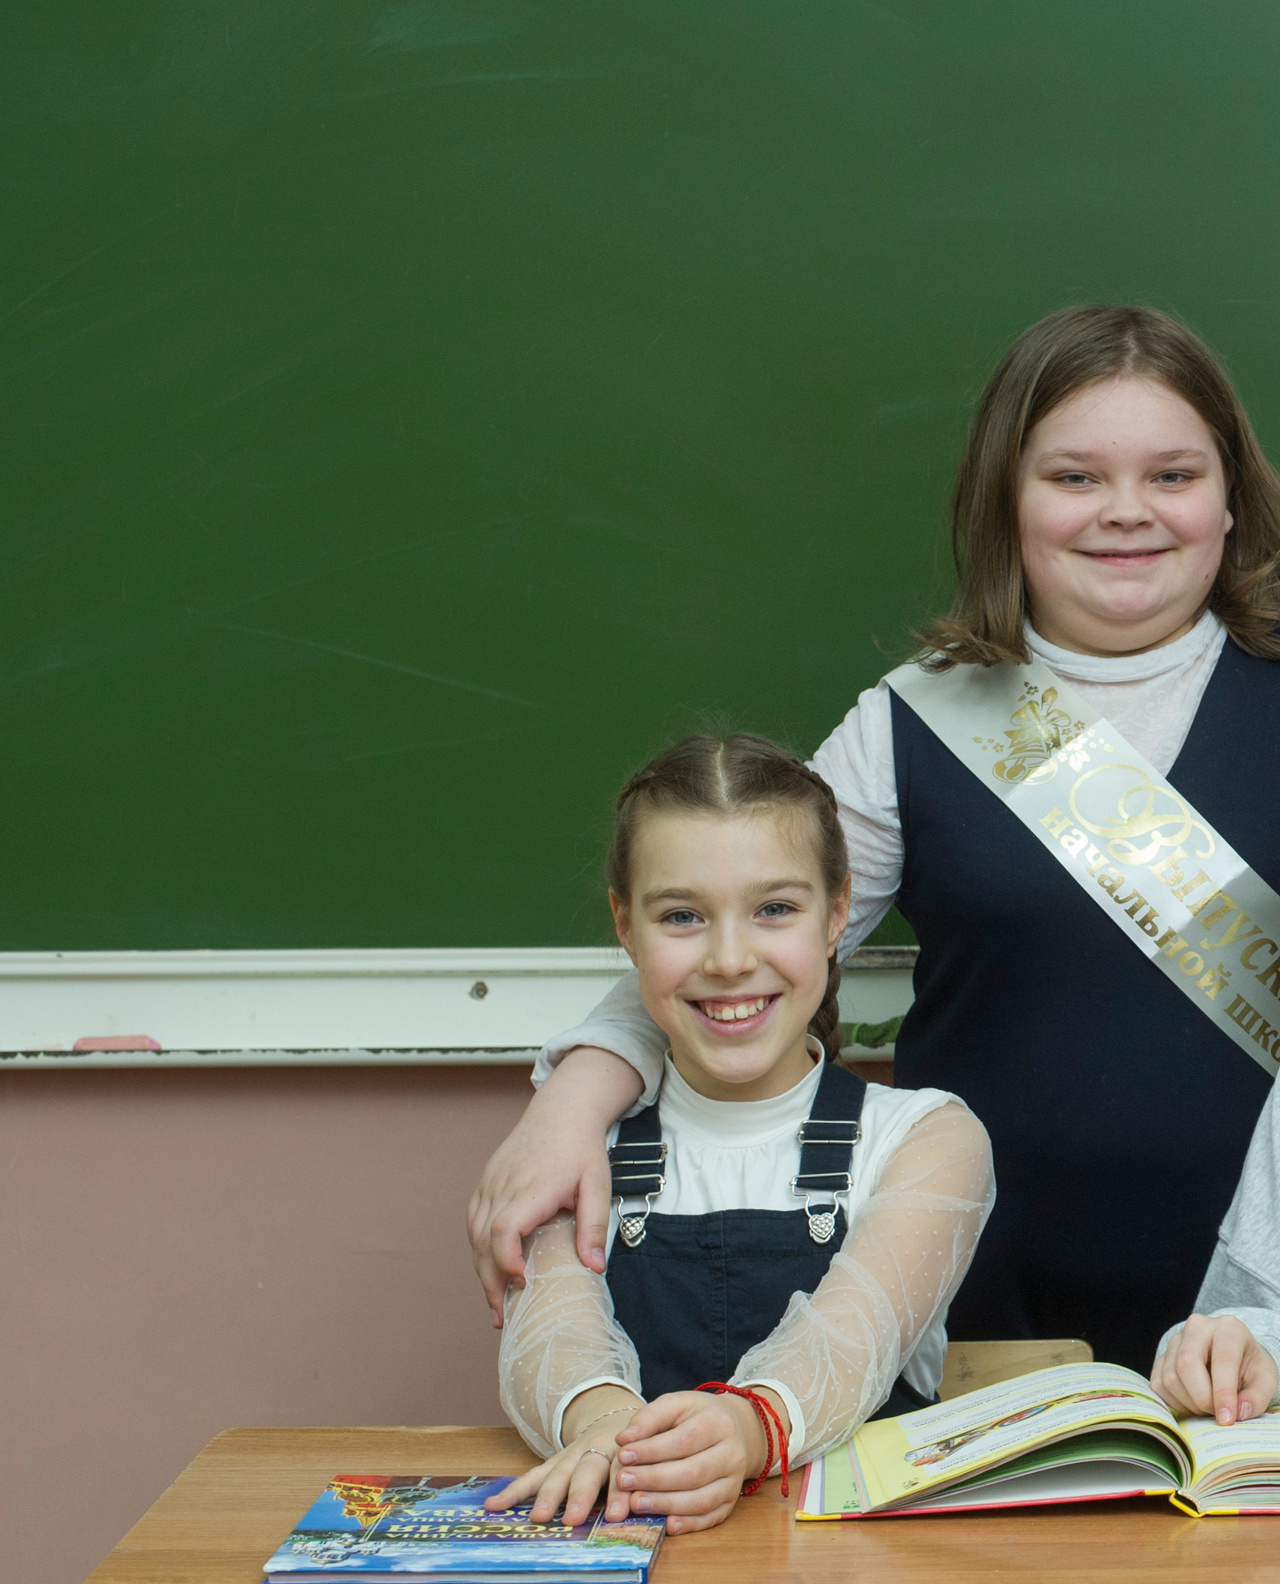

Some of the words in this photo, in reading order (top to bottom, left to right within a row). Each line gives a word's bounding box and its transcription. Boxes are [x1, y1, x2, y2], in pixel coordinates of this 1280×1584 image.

[1038, 806, 1234, 1000] начальной
[401, 1508, 563, 1516] ОСКВА
[388, 1524, 574, 1533] РОССИЯ
